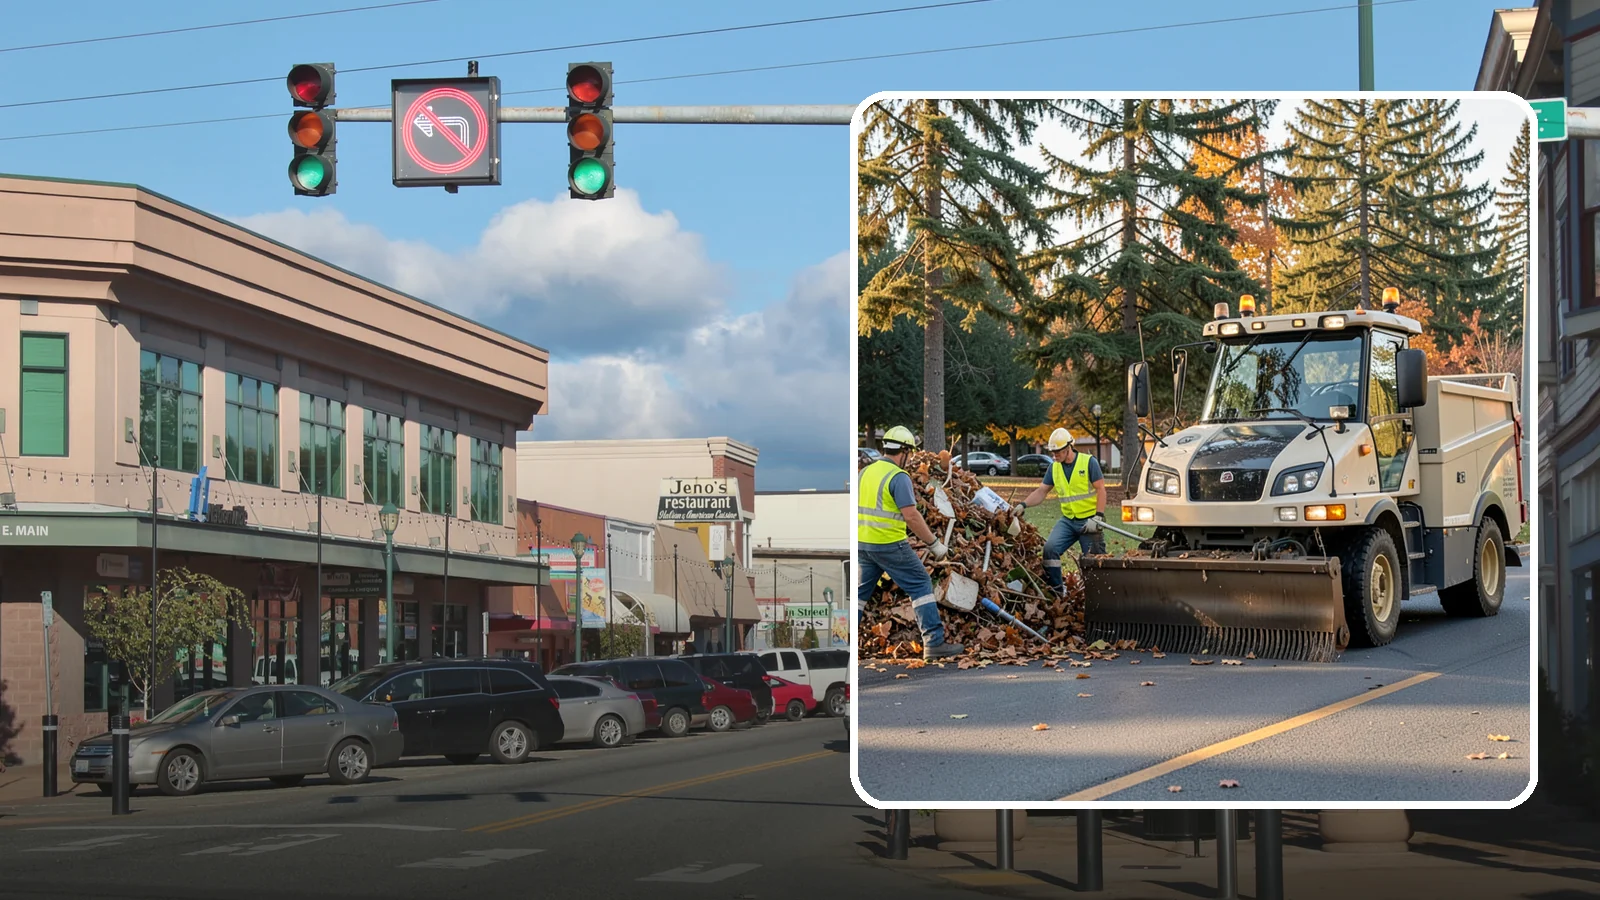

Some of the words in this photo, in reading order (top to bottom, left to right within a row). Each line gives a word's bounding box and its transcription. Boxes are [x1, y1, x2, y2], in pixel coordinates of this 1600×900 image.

[669, 480, 727, 495] Jeno's
[665, 496, 731, 509] restaurant
[686, 510, 714, 520] American
[2, 525, 13, 536] E.
[15, 525, 49, 536] MAIN
[797, 607, 828, 617] Street
[790, 619, 823, 627] lass
